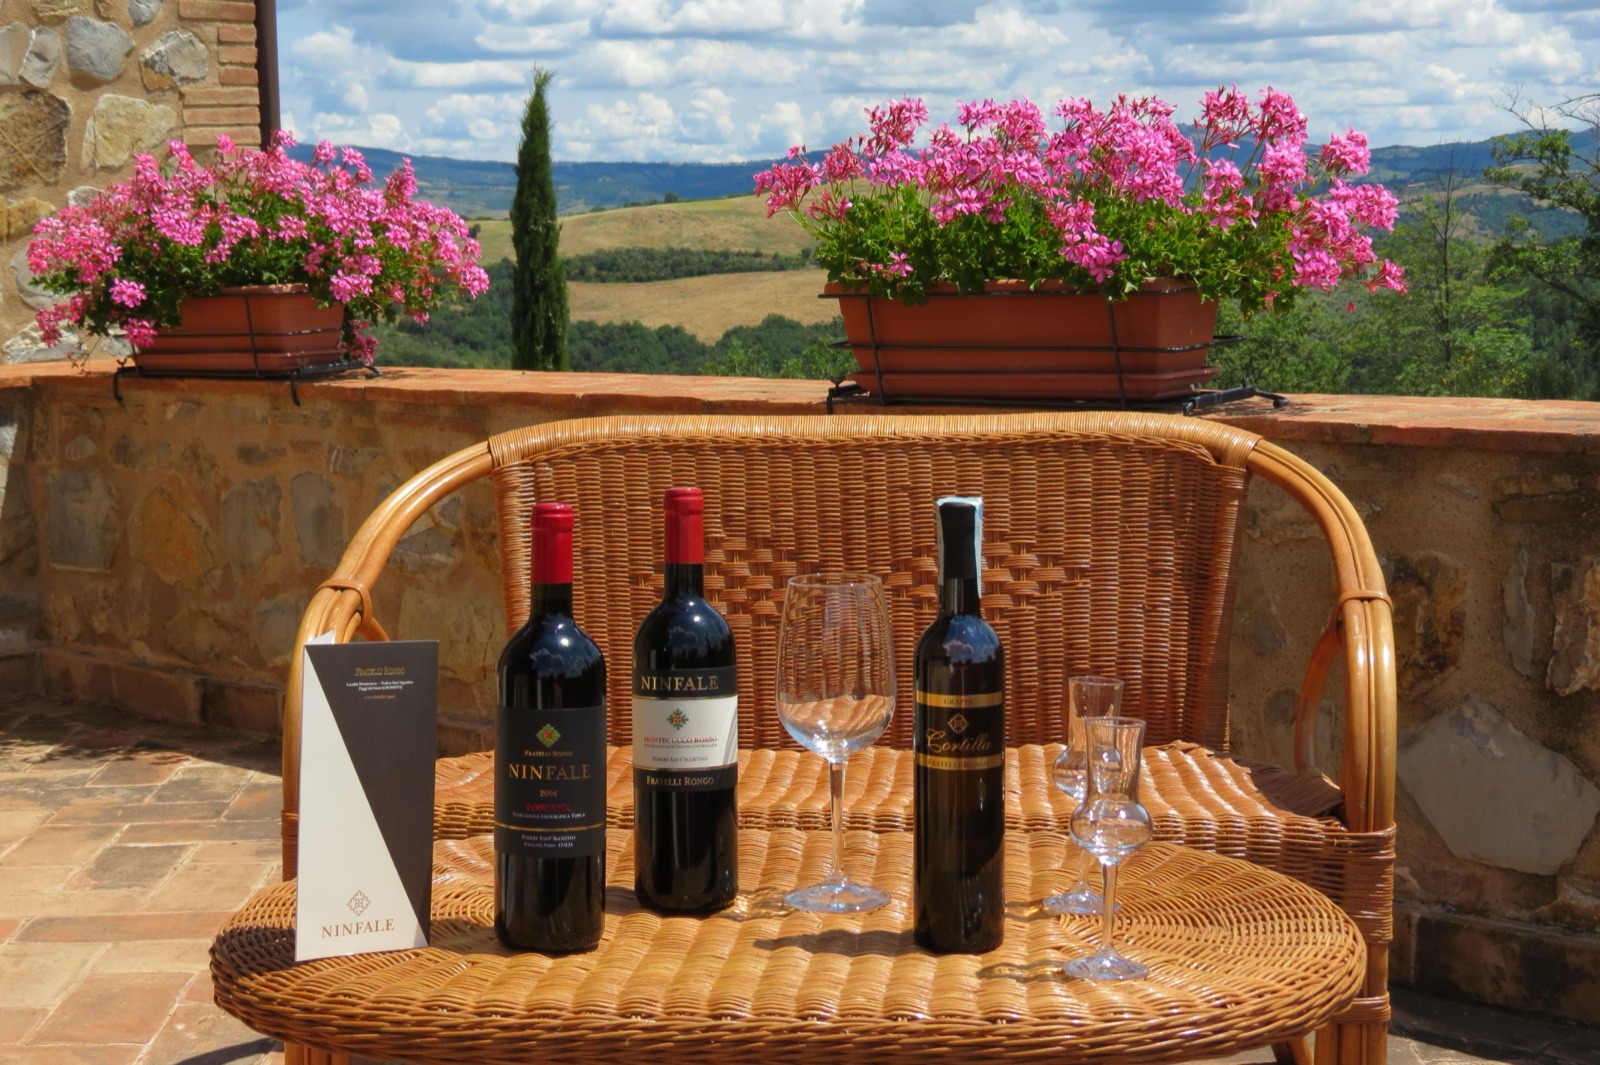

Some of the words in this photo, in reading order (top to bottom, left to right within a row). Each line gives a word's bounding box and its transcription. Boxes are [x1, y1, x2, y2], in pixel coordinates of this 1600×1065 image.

[641, 675, 719, 691] NINFALE
[644, 736, 692, 744] MONTECUCCO
[508, 763, 591, 780] NINFALE
[646, 776, 682, 786] FRATELLI
[684, 776, 714, 786] RONGO
[525, 803, 572, 812] TOSCANA
[322, 918, 394, 938] NINFALE
